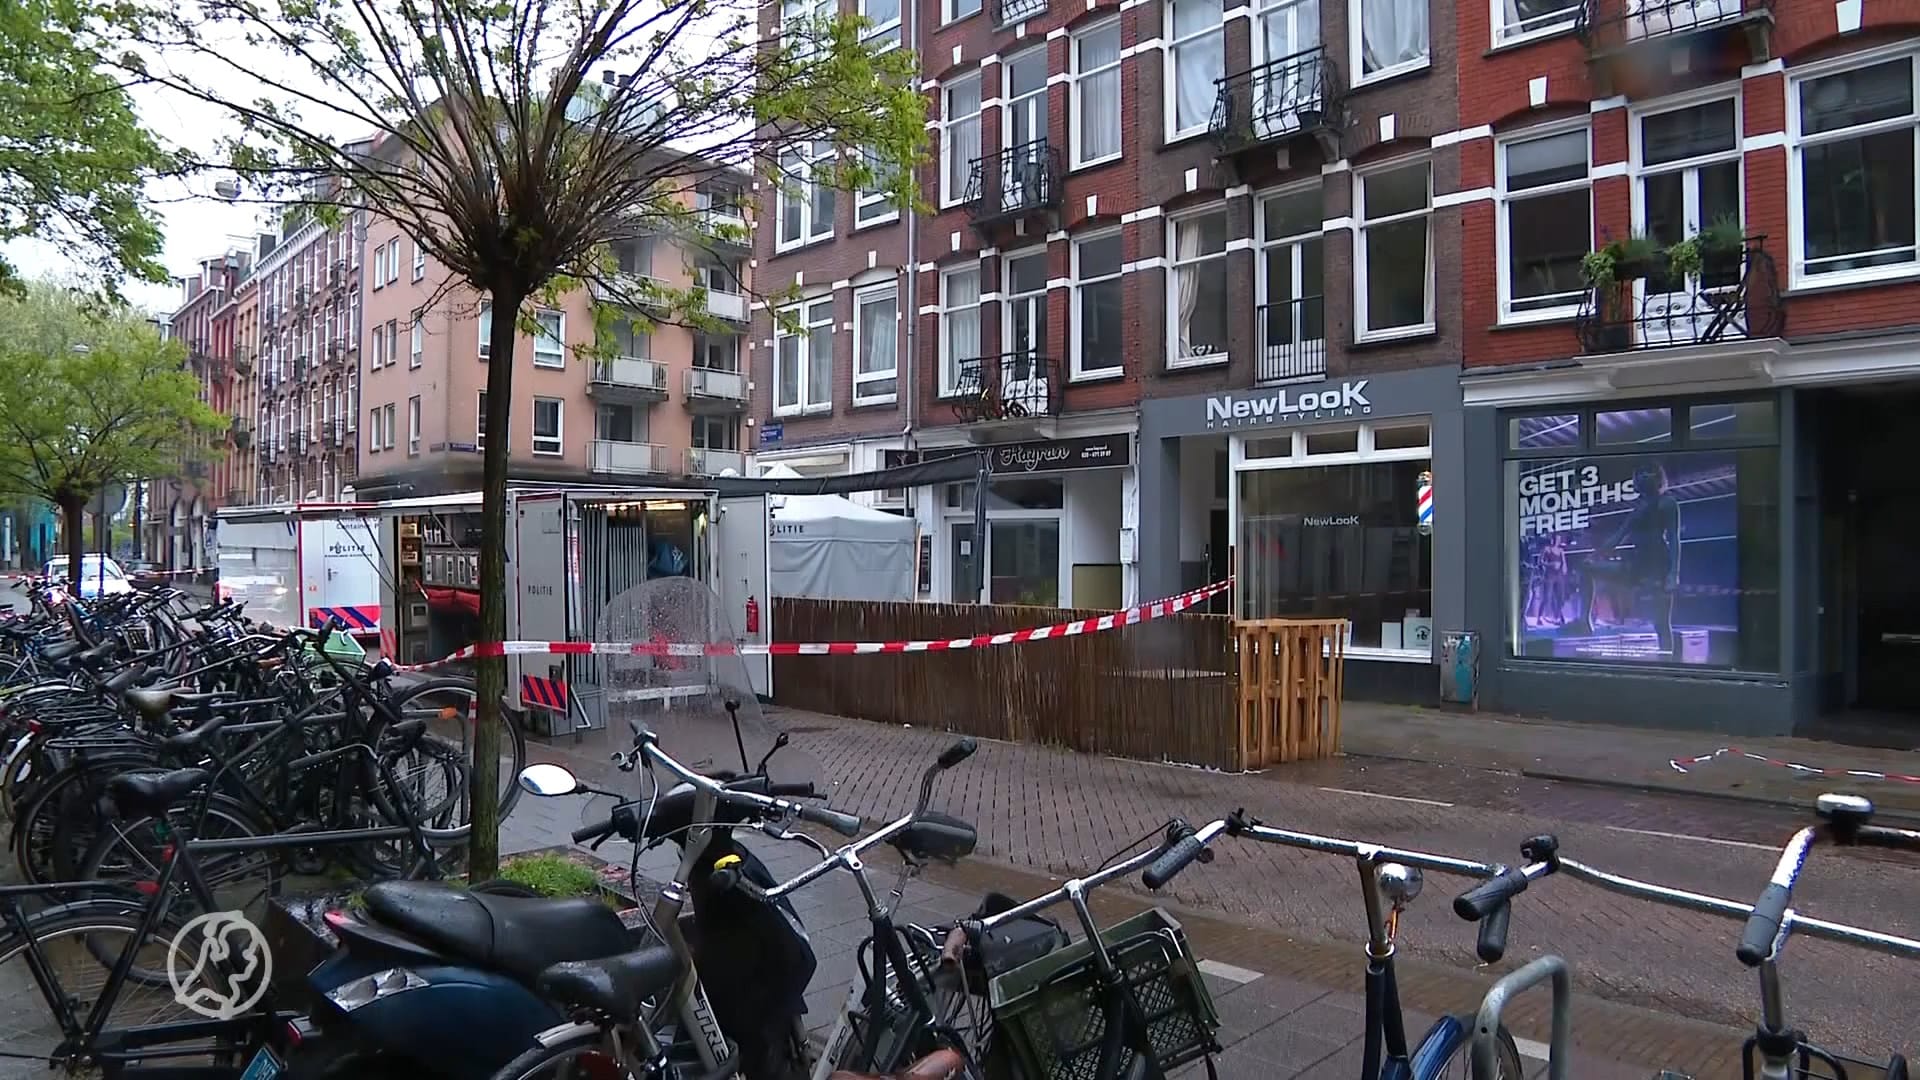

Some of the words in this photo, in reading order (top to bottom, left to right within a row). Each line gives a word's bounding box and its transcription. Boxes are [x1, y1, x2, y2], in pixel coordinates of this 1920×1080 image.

[1207, 406, 1371, 429] HAIRSTYLING
[1519, 469, 1576, 497] GET
[1580, 465, 1599, 487] 3
[1519, 479, 1641, 517] MONTHS
[770, 523, 804, 537] LITIE
[1519, 508, 1590, 537] FREE
[527, 585, 553, 596] POLITIE
